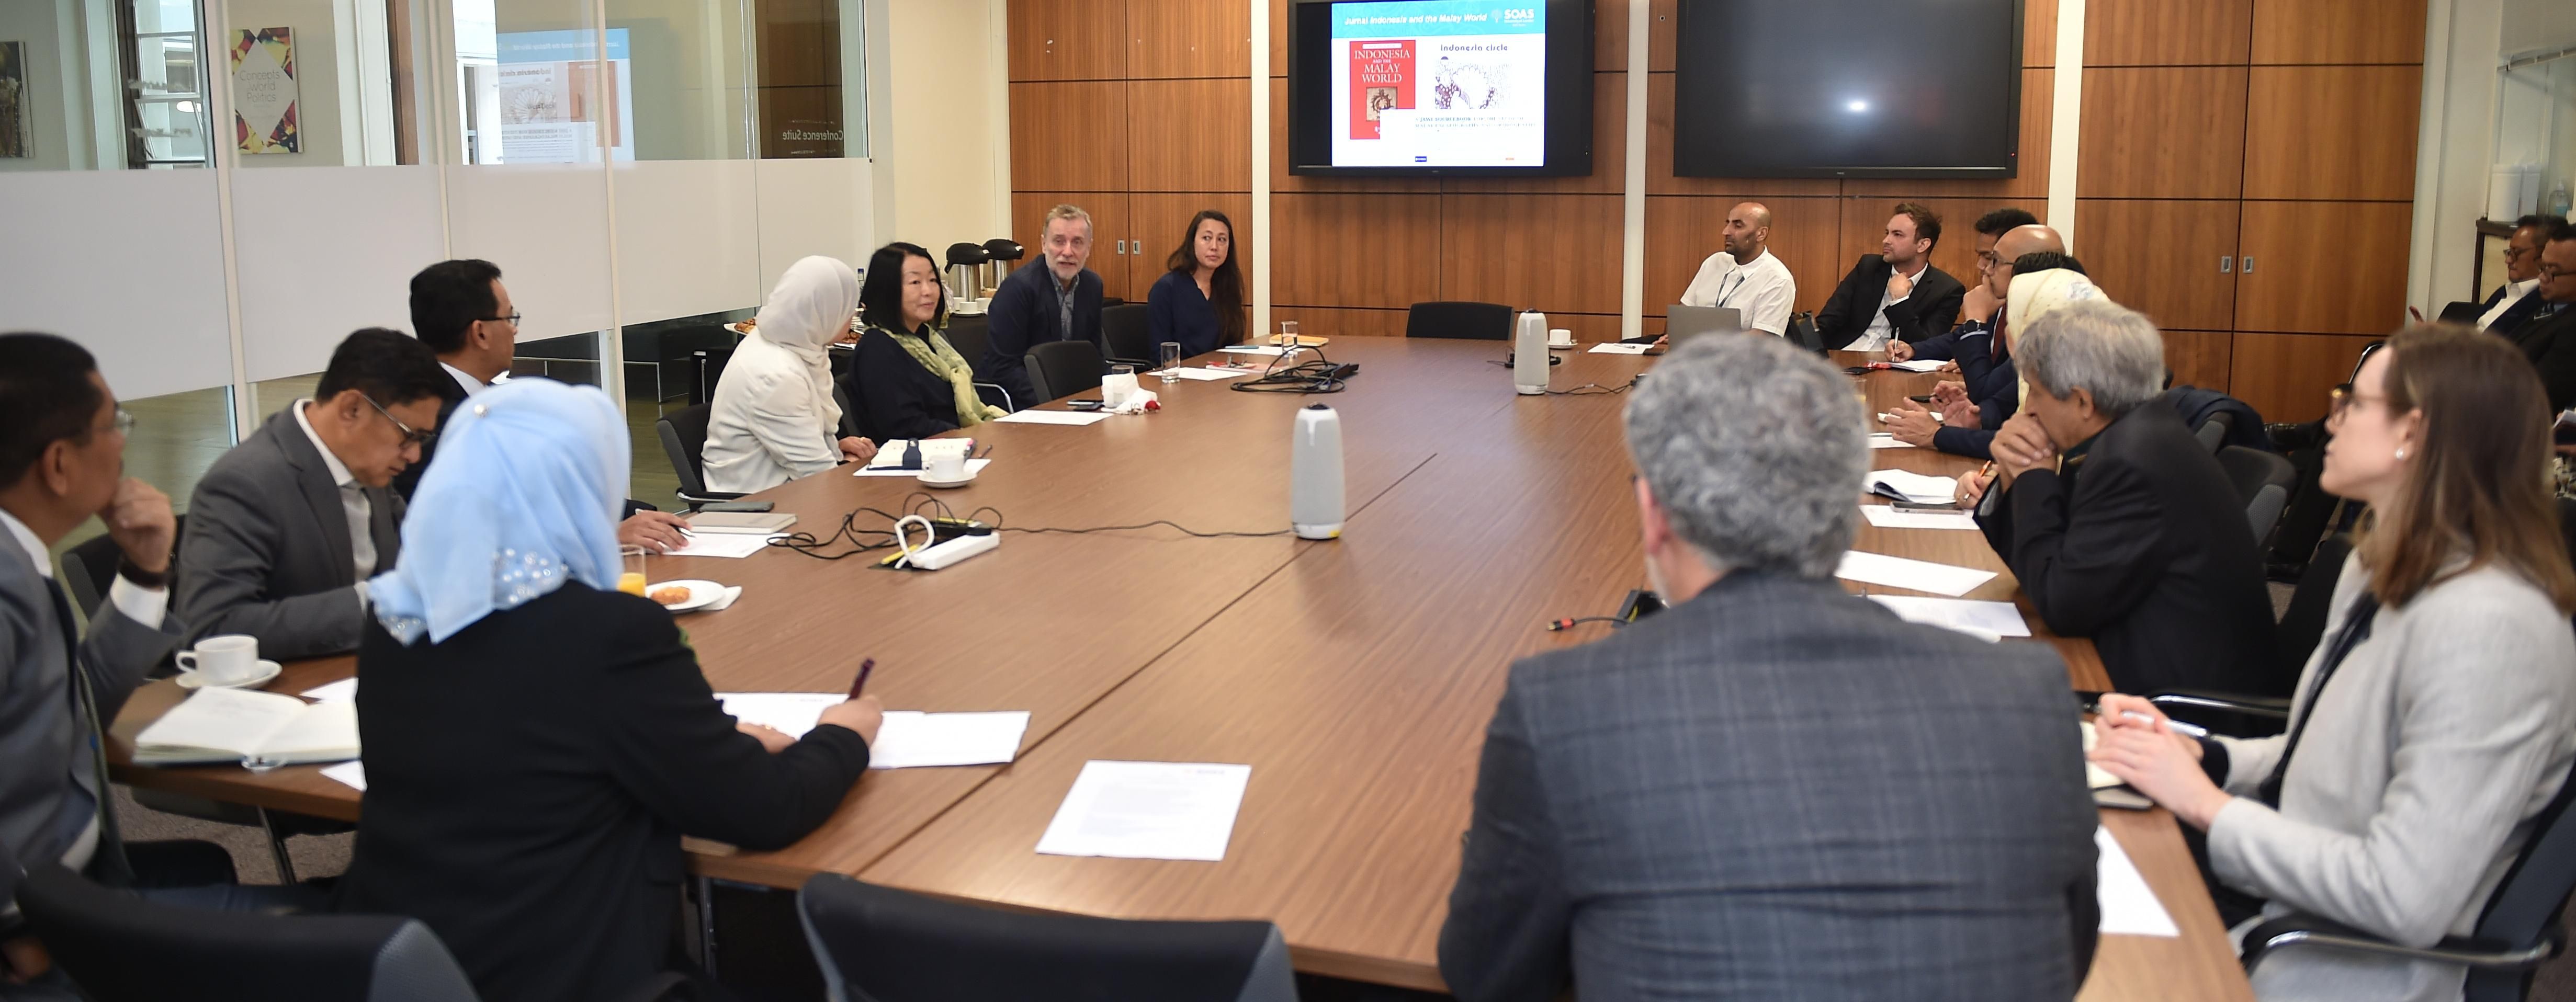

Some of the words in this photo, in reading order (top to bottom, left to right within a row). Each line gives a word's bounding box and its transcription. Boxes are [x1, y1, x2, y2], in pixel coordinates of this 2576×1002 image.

[1345, 16, 1368, 25] Jurnal
[1370, 15, 1407, 25] Indonesia
[1409, 15, 1423, 23] and
[1425, 14, 1437, 23] the
[1439, 14, 1462, 24] Malay
[1464, 13, 1487, 21] World
[1504, 8, 1534, 19] SOAS
[1354, 49, 1410, 59] INDONESIA
[1364, 63, 1400, 73] MALAY
[240, 70, 280, 82] Concepts
[1362, 73, 1403, 84] WORLD
[247, 92, 276, 103] Politics
